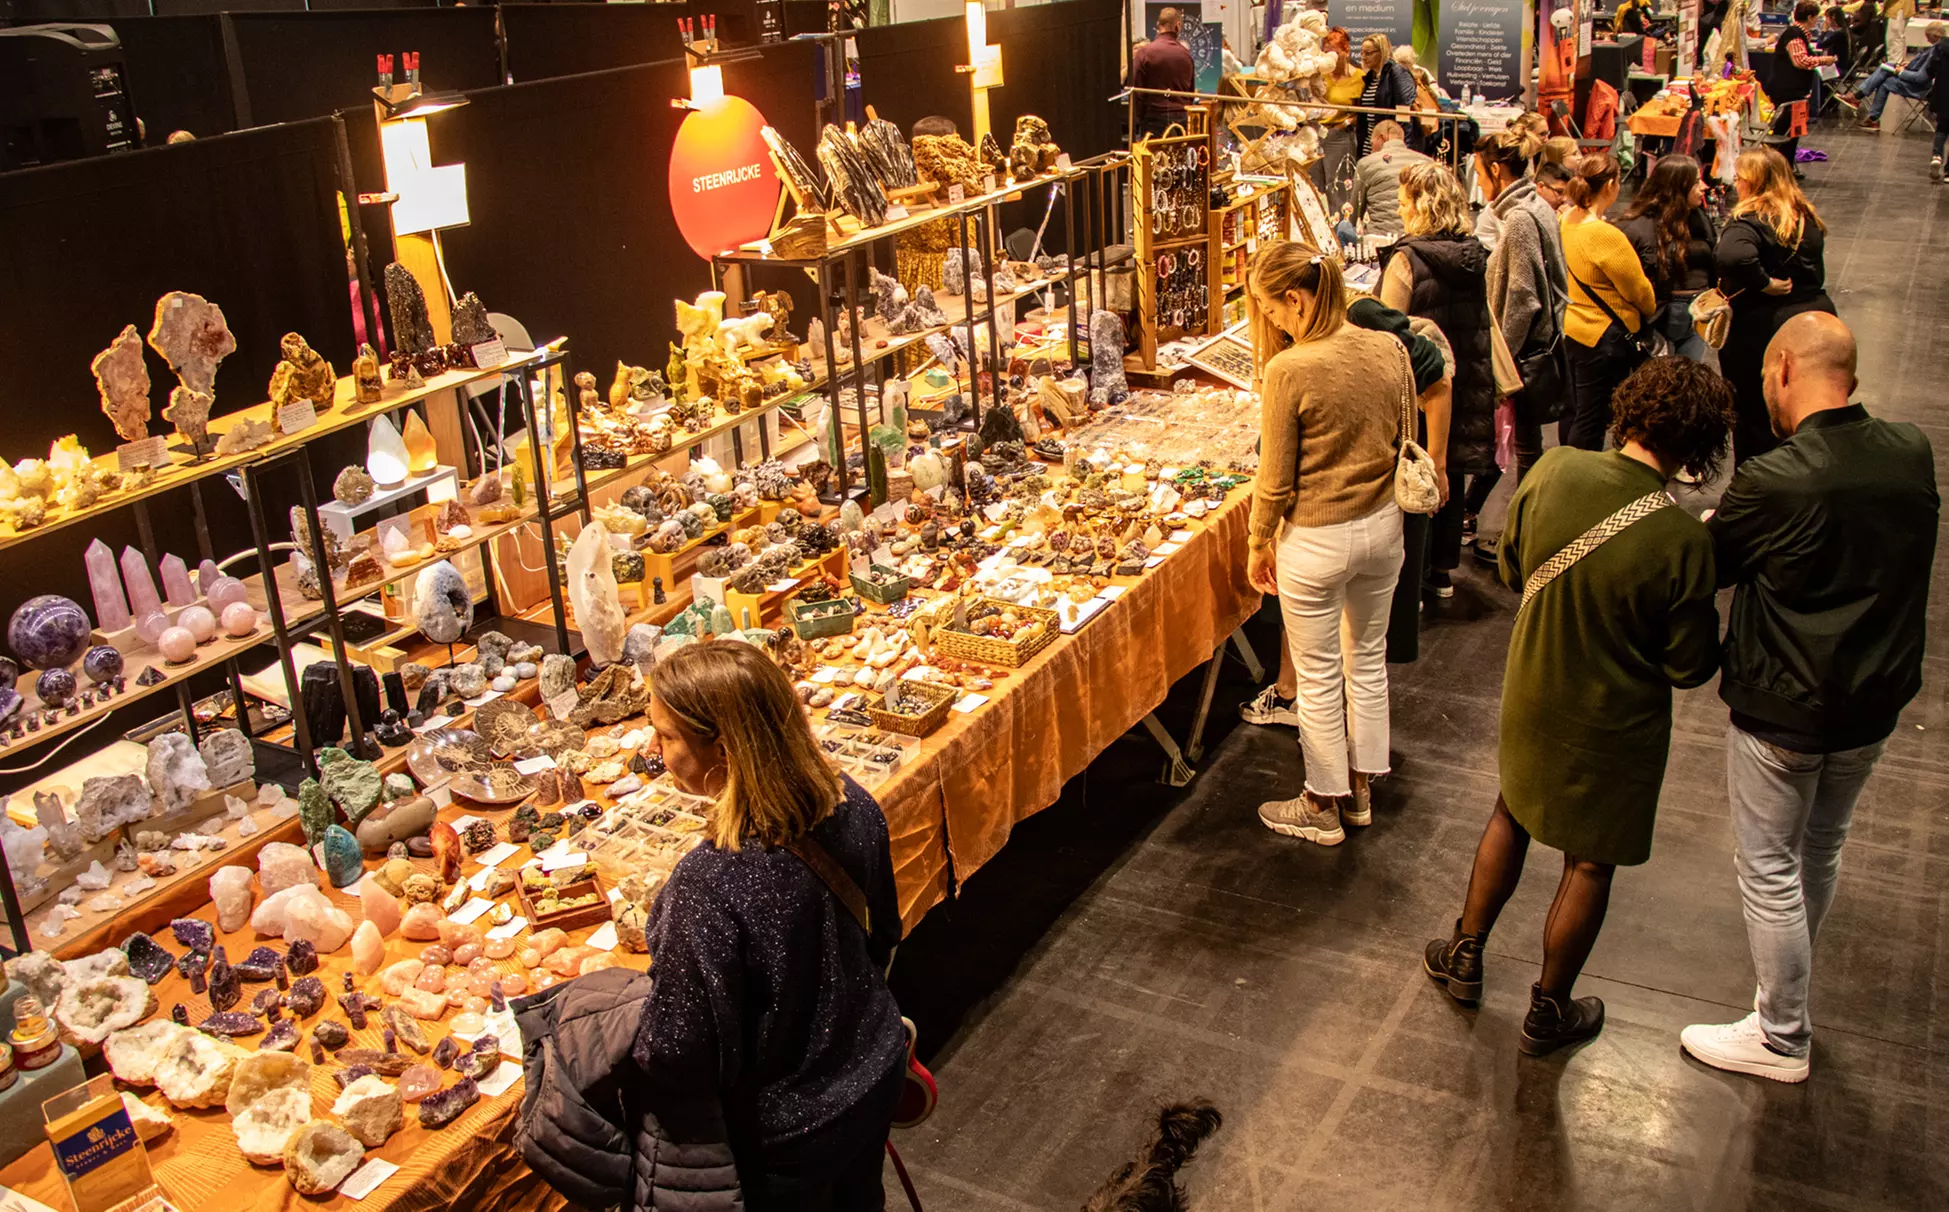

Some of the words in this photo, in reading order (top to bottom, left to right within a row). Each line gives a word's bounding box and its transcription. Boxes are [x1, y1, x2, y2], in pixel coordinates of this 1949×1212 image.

[1359, 4, 1395, 12] medium
[1450, 42, 1486, 50] Gezondheid
[692, 163, 761, 193] STEENRIJCKE
[65, 1126, 132, 1166] Steenrijcke
